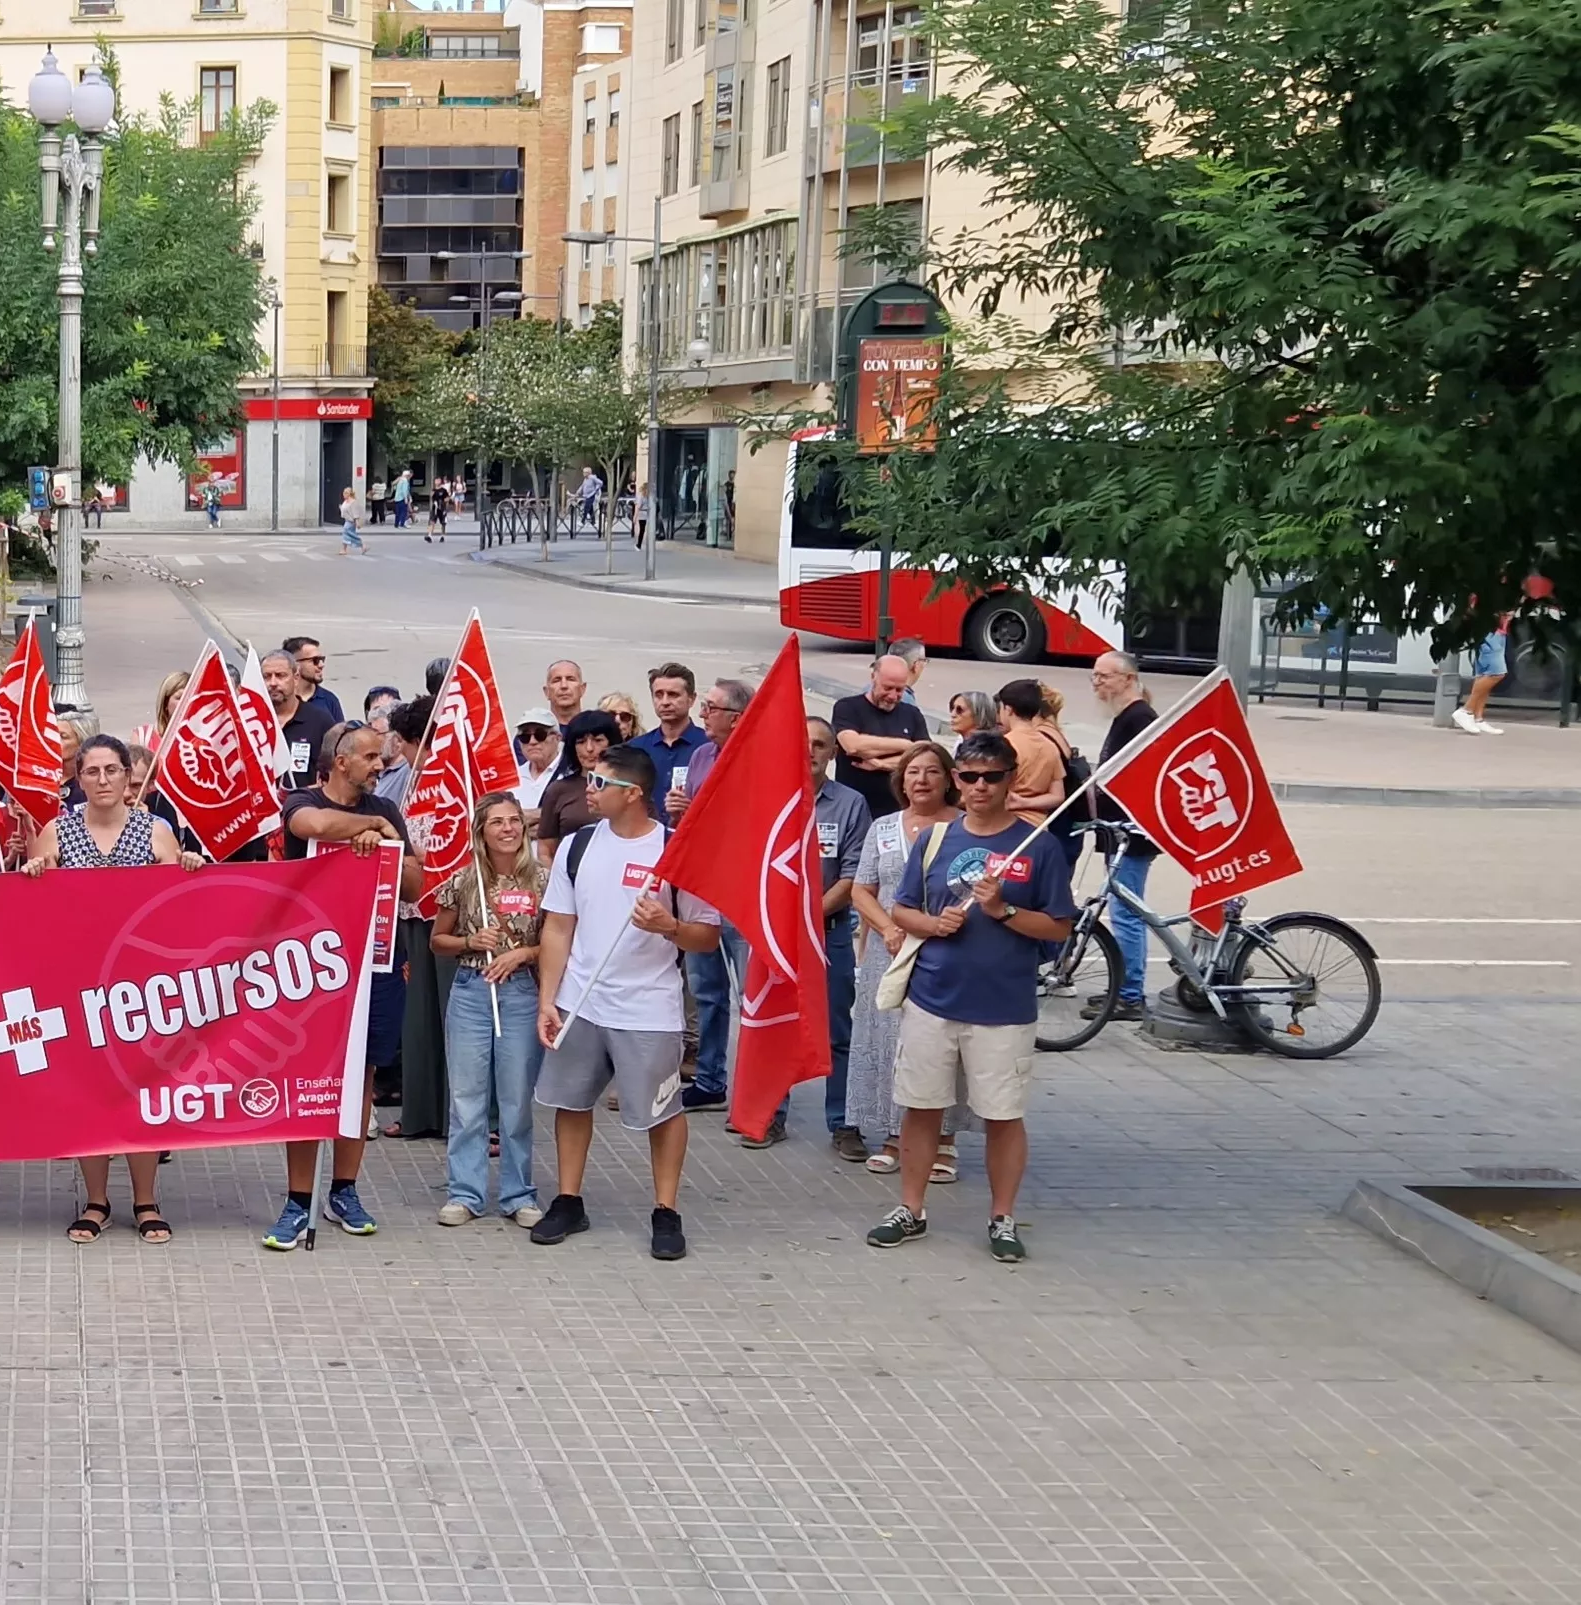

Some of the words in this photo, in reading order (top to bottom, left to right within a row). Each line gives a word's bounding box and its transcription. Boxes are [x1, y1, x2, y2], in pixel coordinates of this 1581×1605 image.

[863, 360, 889, 371] CON
[893, 359, 938, 371] TIEMPO
[326, 403, 360, 415] Santander
[626, 869, 646, 879] UGT
[501, 895, 521, 905] UGT
[6, 1015, 43, 1046] MÁS
[80, 929, 349, 1048] recursos
[296, 1076, 343, 1089] Enseña
[298, 1091, 338, 1104] Aragón
[139, 1083, 233, 1125] UGT
[297, 1107, 336, 1117] Servicios
